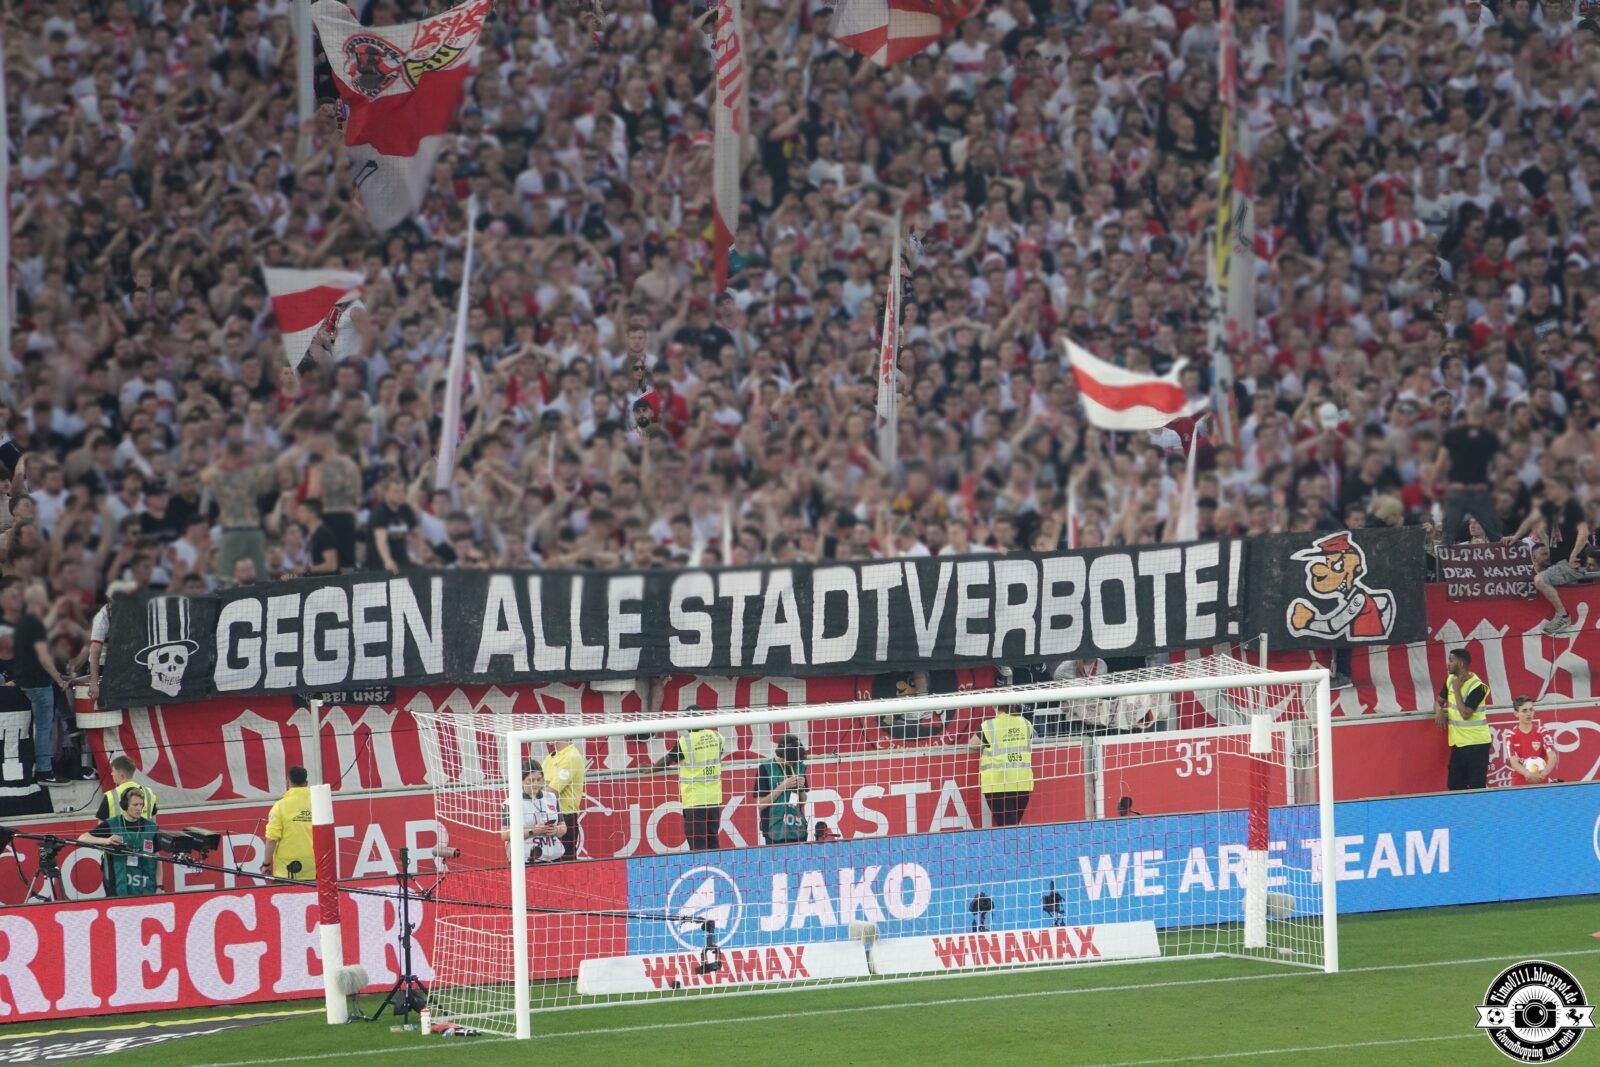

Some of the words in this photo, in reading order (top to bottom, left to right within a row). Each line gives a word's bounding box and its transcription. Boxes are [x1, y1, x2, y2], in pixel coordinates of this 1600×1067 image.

[1439, 547, 1495, 562] ULTRA
[1501, 545, 1530, 560] IST
[1443, 567, 1476, 579] DER
[1482, 564, 1534, 578] KAMPF
[1448, 583, 1481, 597] UMS
[1484, 581, 1537, 597] GANZE
[213, 577, 444, 692] GEGEN
[473, 574, 644, 673] ALLE
[668, 540, 1243, 668] STADTVERBOTE!
[321, 691, 347, 702] BEI
[353, 690, 390, 702] UNS!
[1175, 741, 1212, 778] 35
[759, 861, 931, 932] JAKO
[1079, 850, 1165, 901] WE
[1178, 841, 1287, 893] ARE
[1301, 828, 1450, 883] TEAM
[933, 926, 1101, 969] WINAMAX
[642, 946, 810, 989] WINAMAX
